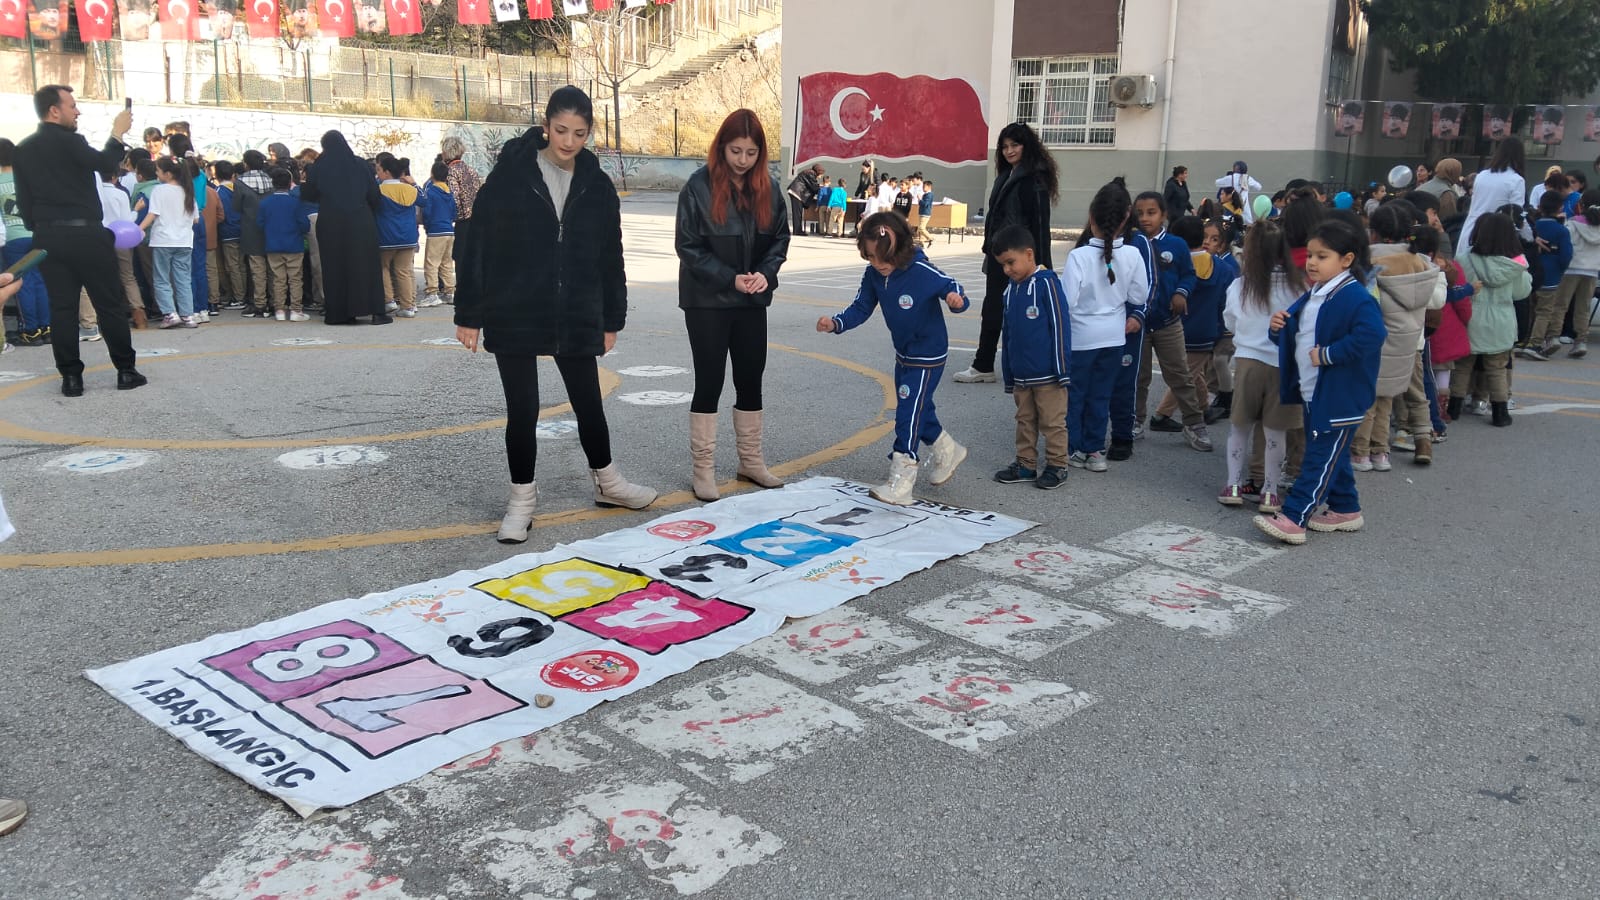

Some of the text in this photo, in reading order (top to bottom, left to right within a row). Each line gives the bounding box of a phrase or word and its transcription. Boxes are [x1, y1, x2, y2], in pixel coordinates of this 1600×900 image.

[816, 506, 873, 527] 1
[741, 527, 832, 556] 2
[658, 553, 748, 583] 3
[1013, 550, 1073, 573] 3
[508, 569, 618, 605] 5
[595, 596, 704, 630] 4
[964, 604, 1038, 627] 4
[446, 615, 555, 659] 6
[250, 635, 379, 682] 8
[556, 666, 605, 687] SDF
[316, 685, 472, 733] 7
[916, 675, 1013, 714] 5
[131, 678, 317, 790] 1.BAŞLANGIÇ
